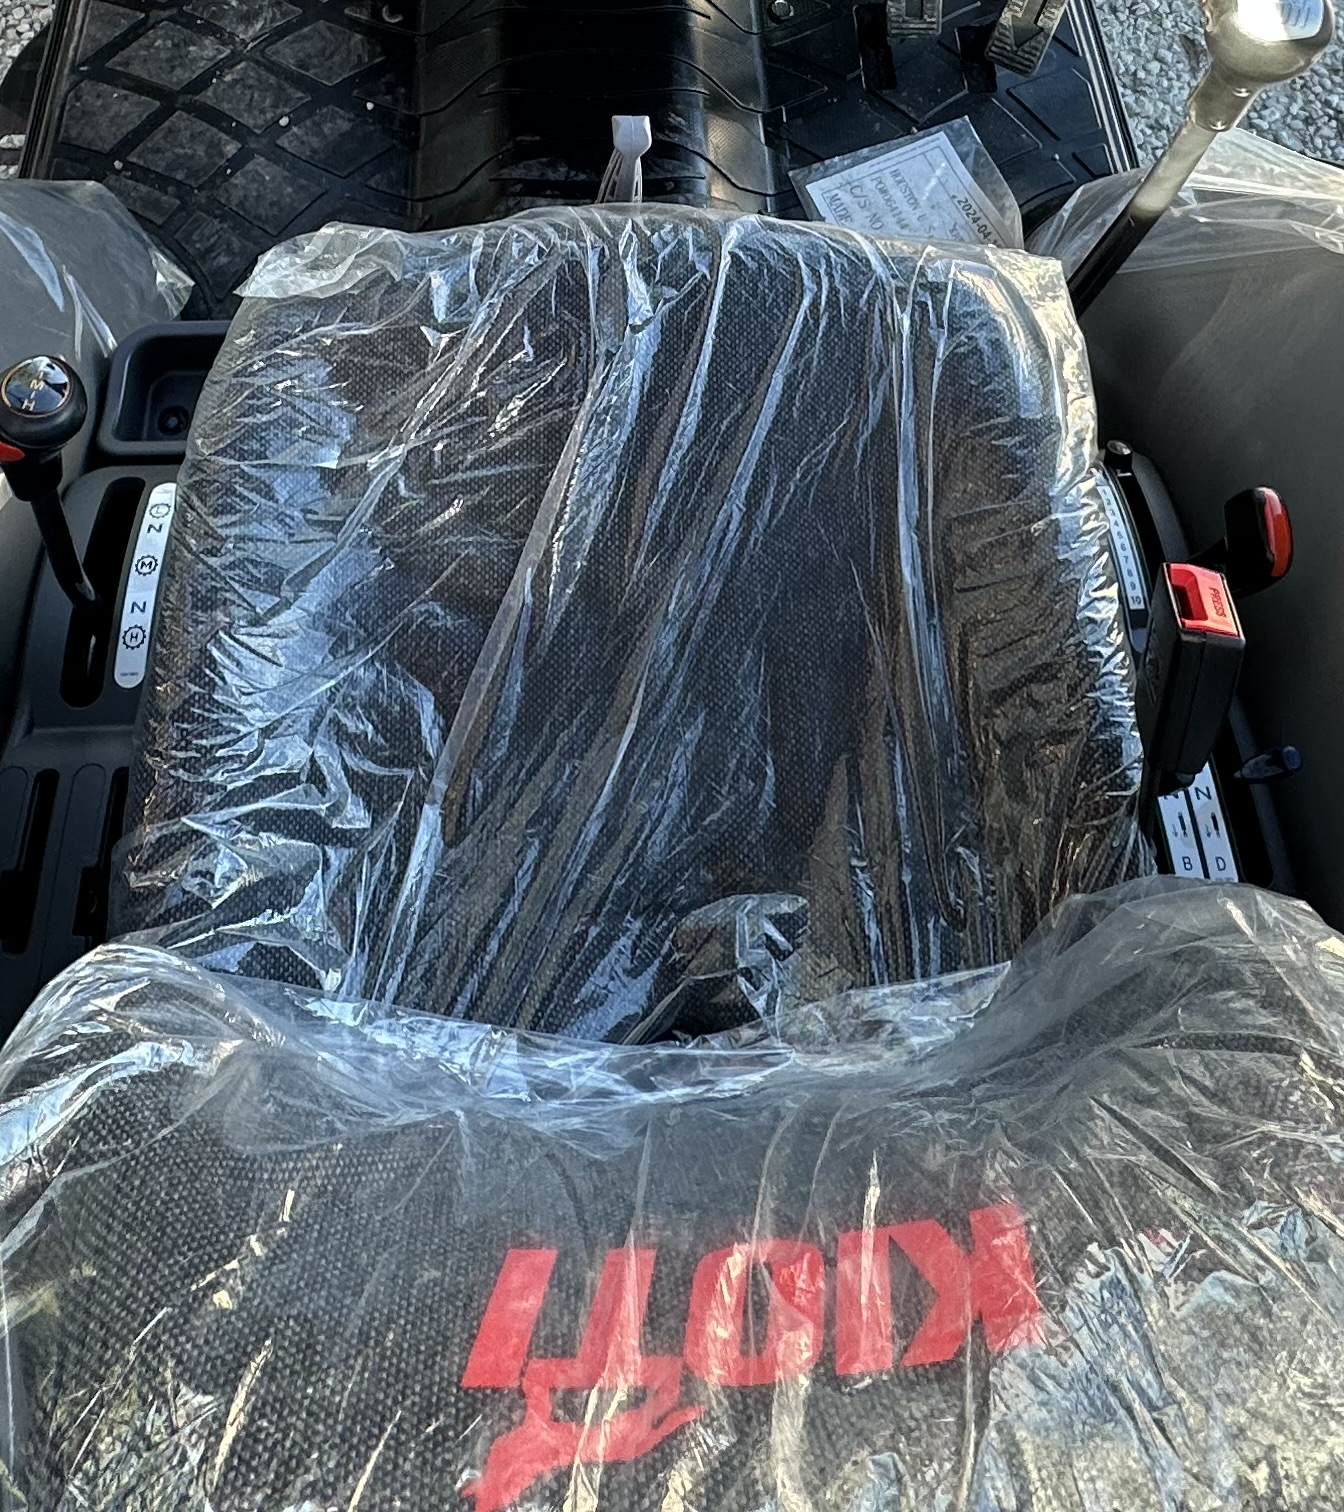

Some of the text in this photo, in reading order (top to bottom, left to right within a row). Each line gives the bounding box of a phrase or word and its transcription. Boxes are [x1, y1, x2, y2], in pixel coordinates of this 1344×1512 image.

[29, 379, 45, 391] M
[22, 399, 35, 411] H
[146, 523, 164, 534] N
[130, 600, 147, 614] N
[1130, 595, 1142, 606] 10
[1194, 785, 1212, 800] N
[1181, 856, 1193, 871] B
[1214, 856, 1227, 871] D
[460, 1201, 1048, 1393] KIOTI
